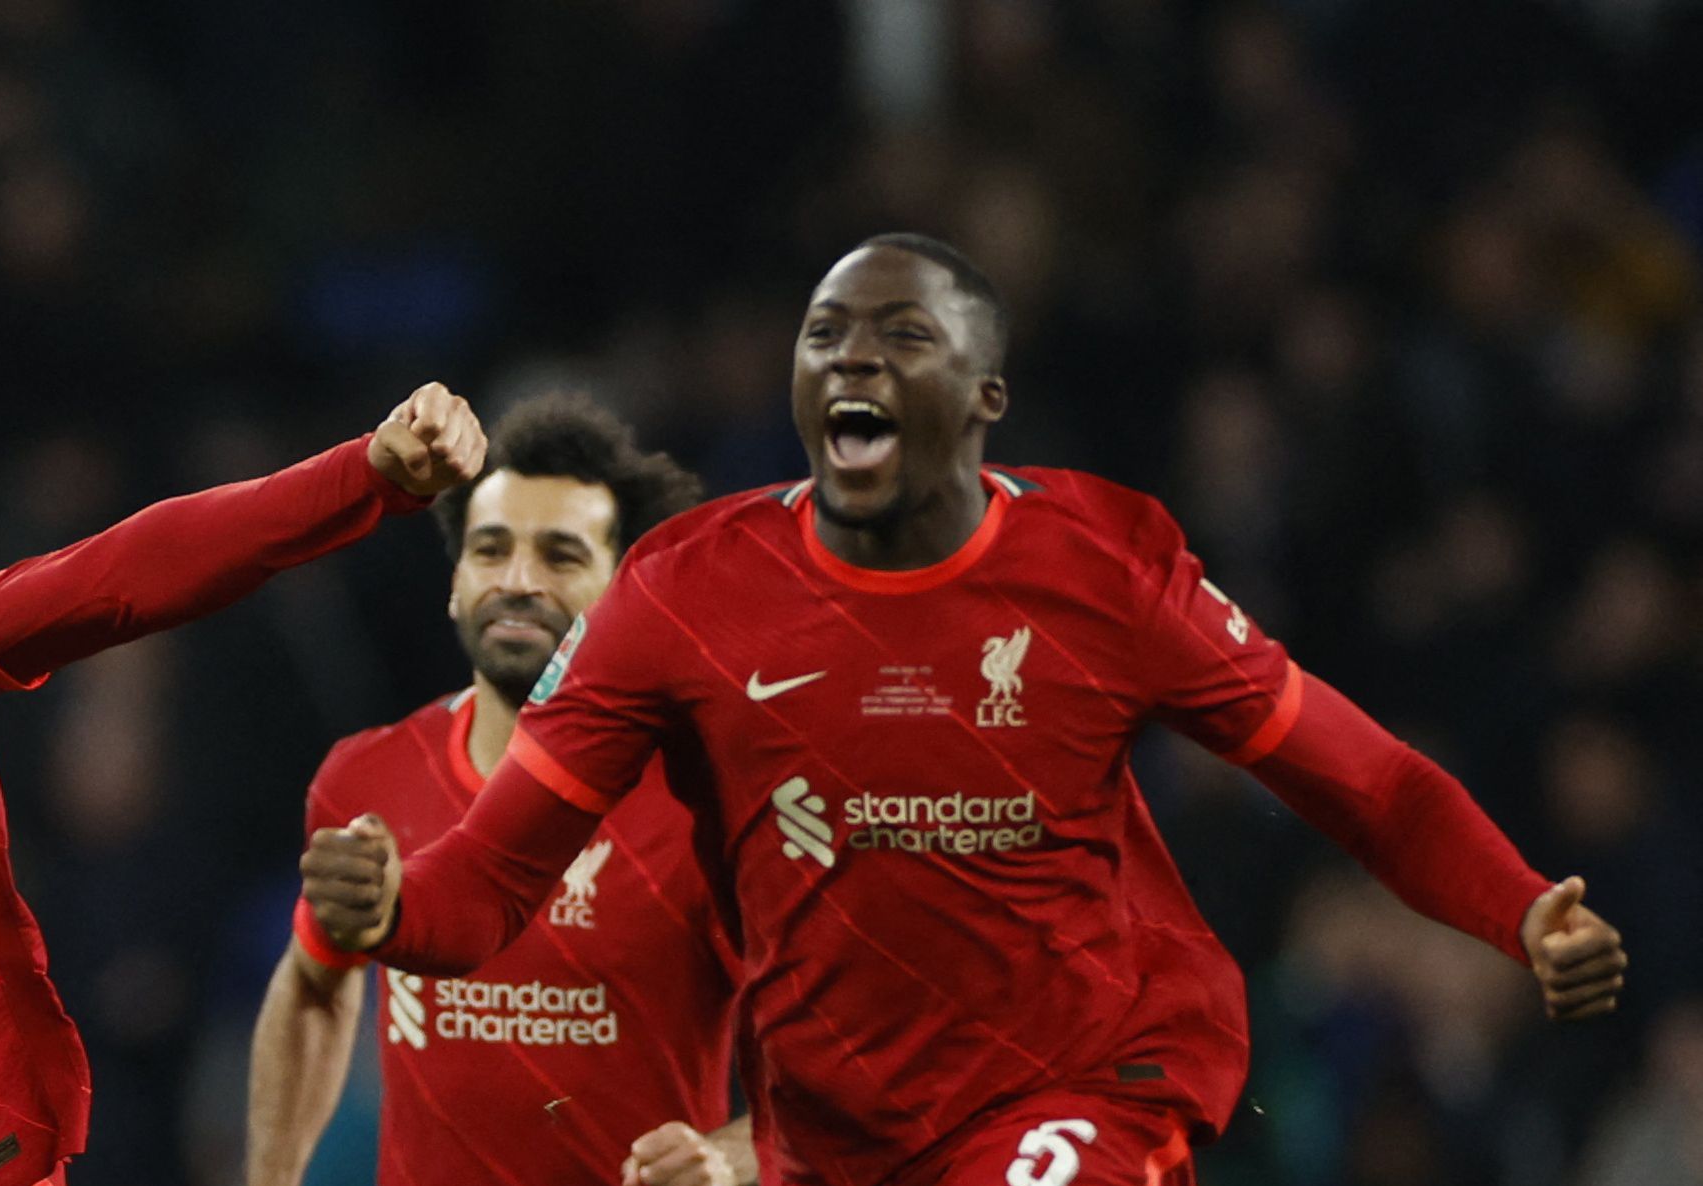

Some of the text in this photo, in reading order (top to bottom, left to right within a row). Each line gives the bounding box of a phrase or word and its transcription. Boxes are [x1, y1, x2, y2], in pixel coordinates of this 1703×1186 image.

[844, 791, 1035, 825] standard
[847, 822, 1042, 855] chartered
[435, 979, 606, 1014] standard
[435, 1008, 618, 1045] chartered
